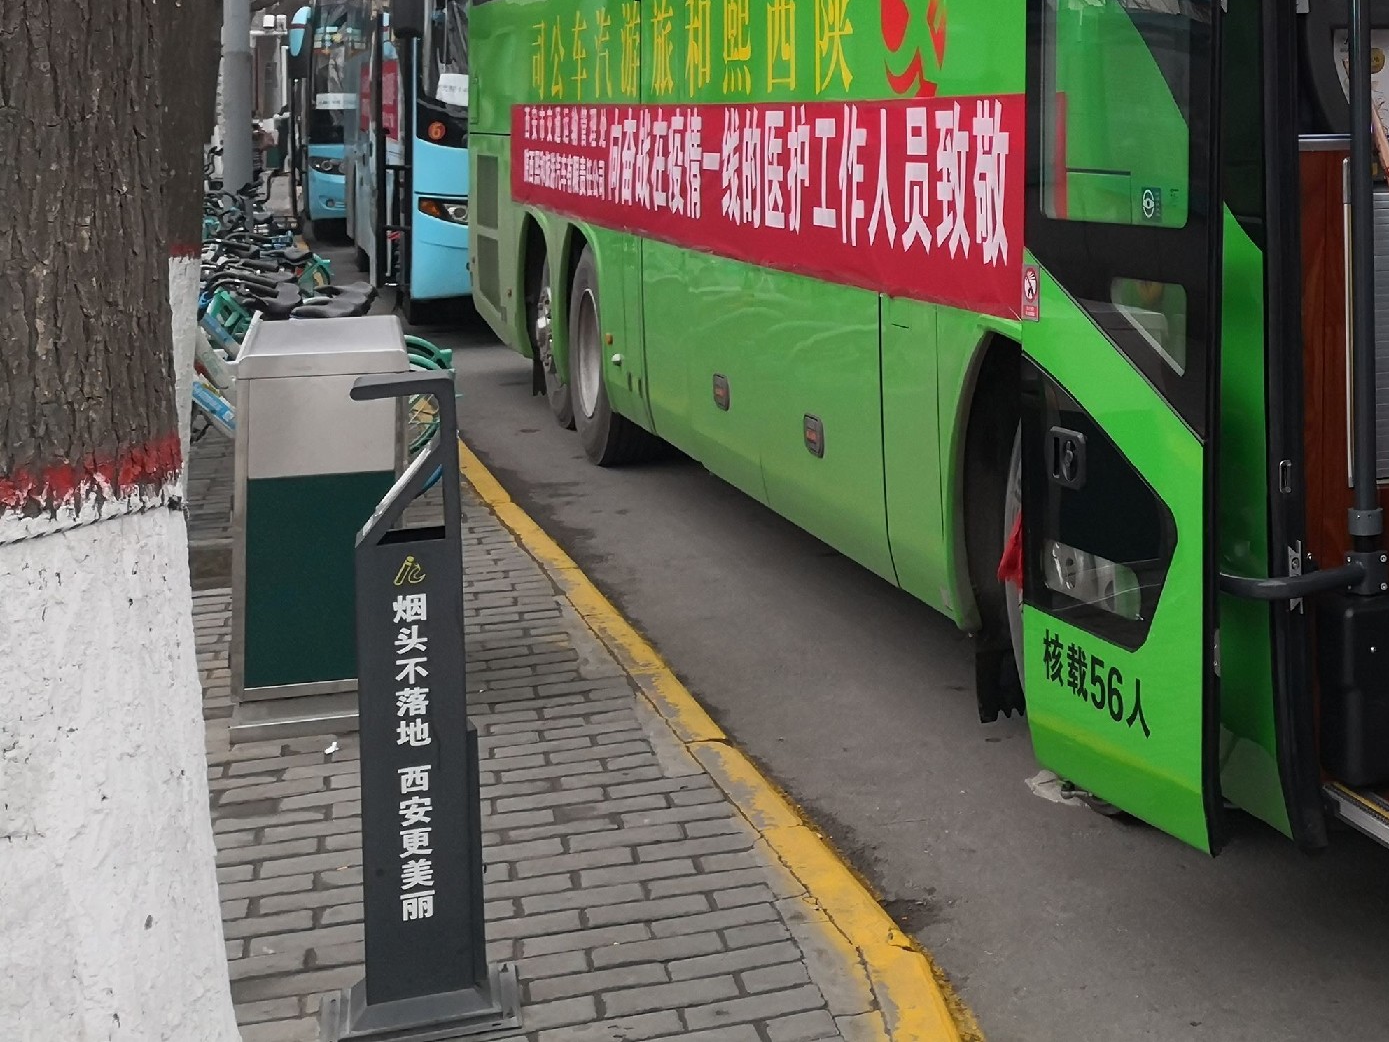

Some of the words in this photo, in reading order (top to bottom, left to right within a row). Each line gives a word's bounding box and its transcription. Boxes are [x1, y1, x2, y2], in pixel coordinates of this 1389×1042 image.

[608, 100, 1010, 267] 向奋战在疫情一线的医护工作人员致敬
[393, 593, 432, 747] 烟头不落地
[1043, 628, 1151, 739] 核载56人
[397, 764, 436, 922] 西安更美丽
